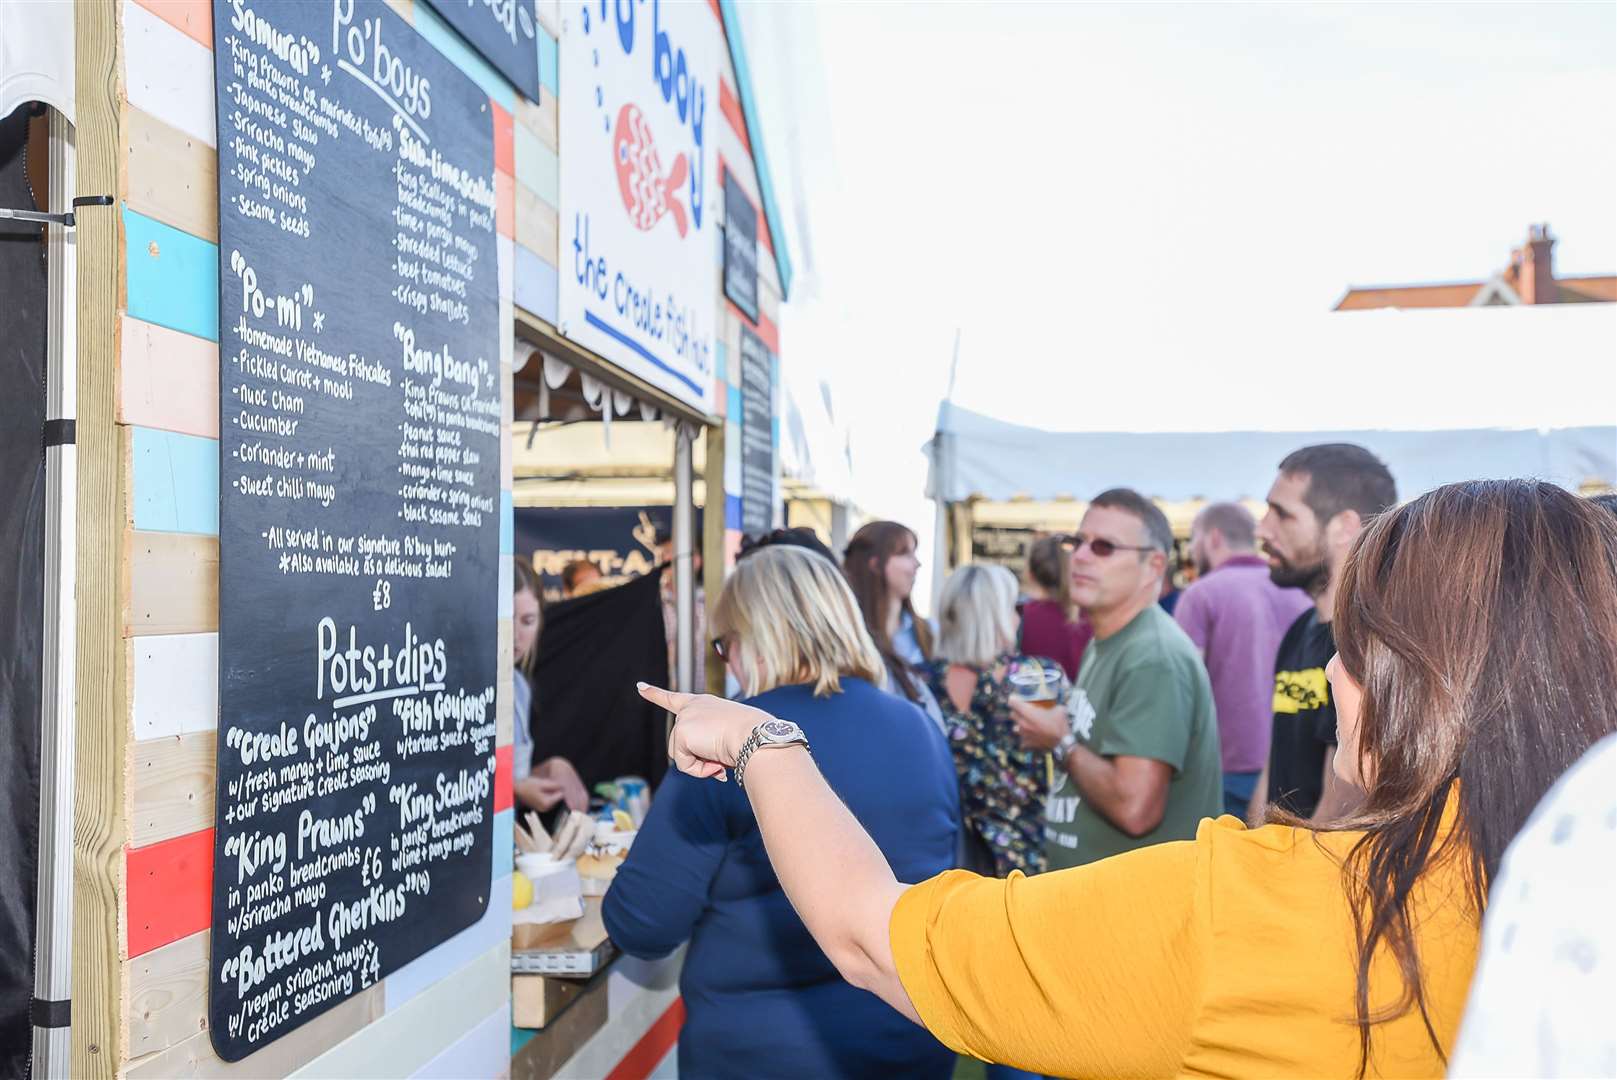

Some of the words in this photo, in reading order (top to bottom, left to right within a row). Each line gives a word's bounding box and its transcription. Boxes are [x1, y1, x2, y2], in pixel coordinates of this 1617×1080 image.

[228, 0, 320, 76] Samurai"
[231, 35, 258, 75] King
[260, 54, 300, 97] Prawns
[234, 56, 245, 78] in
[232, 82, 287, 128] Japanese
[261, 153, 299, 186] pickles
[287, 143, 315, 175] mayo
[272, 183, 306, 214] onions
[574, 212, 608, 300] the
[238, 315, 293, 357] Homemade
[295, 338, 347, 376] Vietnamese
[349, 353, 392, 387] Fishcakes
[240, 349, 278, 381] Pickled
[324, 378, 353, 400] mooli
[436, 428, 461, 446] sauce
[307, 447, 335, 472] mint
[420, 444, 434, 459] red
[435, 446, 461, 464] pepper
[276, 475, 304, 500] chilli
[306, 481, 336, 507] mayo
[403, 502, 427, 522] black
[286, 527, 318, 551] served
[321, 531, 333, 552] in
[338, 536, 354, 553] our
[358, 533, 400, 561] signature
[315, 554, 360, 576] available
[385, 557, 423, 578] delicious
[372, 579, 391, 611] £8
[440, 731, 463, 751] sauce
[280, 762, 315, 784] mango
[353, 740, 381, 764] sauce
[262, 780, 315, 813] signature
[350, 760, 391, 787] seasoning
[391, 832, 399, 851] in
[228, 886, 240, 909] in
[247, 873, 284, 912] panko
[290, 846, 361, 888] breadcrumbs
[361, 846, 382, 887] £6
[295, 882, 326, 908] mayo
[286, 960, 333, 996] sriracha
[361, 946, 380, 990] £4
[294, 971, 353, 1015] seasoning
